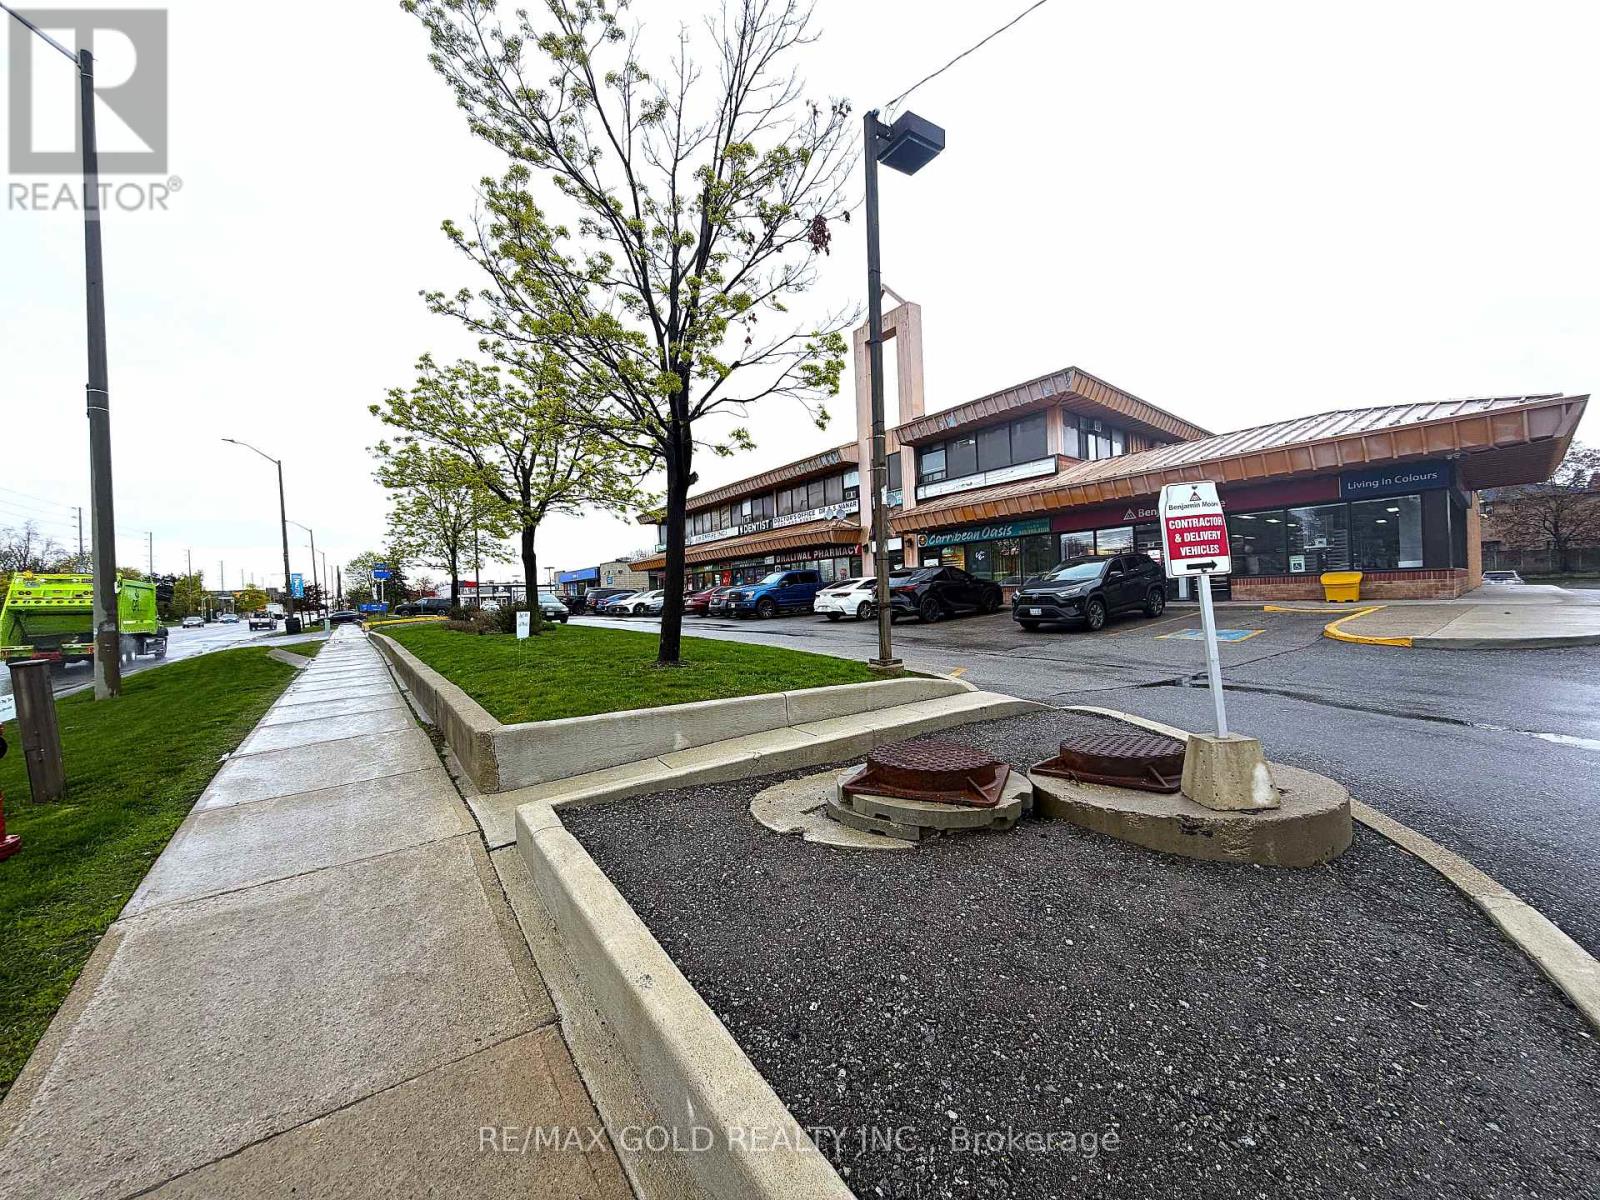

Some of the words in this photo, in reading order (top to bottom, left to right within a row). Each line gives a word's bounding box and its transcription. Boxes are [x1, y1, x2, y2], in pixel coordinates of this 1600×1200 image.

[1347, 480, 1379, 490] Living
[1381, 477, 1392, 486] In
[1394, 472, 1438, 484] Colours
[1168, 502, 1201, 511] Benjamin
[744, 519, 770, 533] DENTIST
[1168, 516, 1223, 530] CONTRACTOR
[981, 525, 1013, 538] Oasis
[1174, 533, 1182, 543] &
[1183, 530, 1221, 542] DELIVERY
[813, 544, 860, 559] PHARMACY
[1180, 544, 1220, 556] VEHICLES
